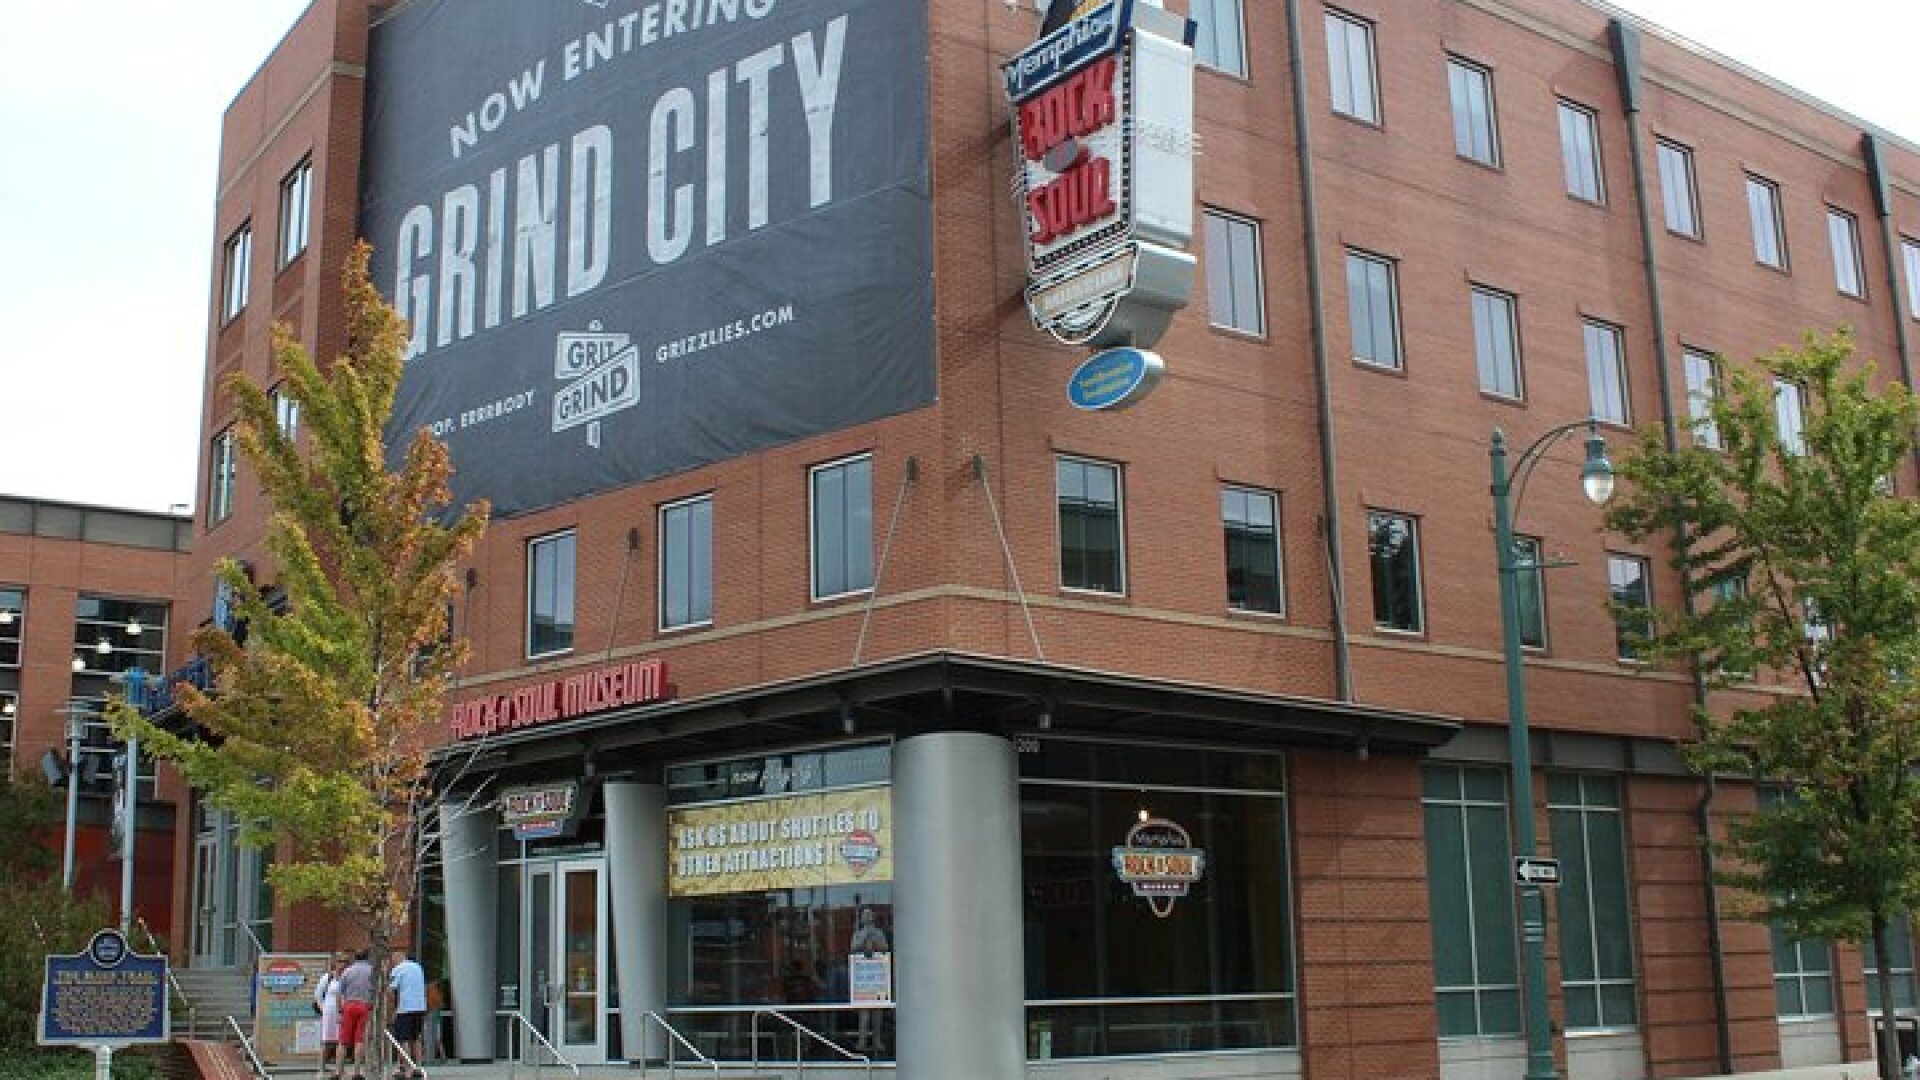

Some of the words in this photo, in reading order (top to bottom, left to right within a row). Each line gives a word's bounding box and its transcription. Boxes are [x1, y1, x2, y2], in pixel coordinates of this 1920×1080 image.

[450, 59, 545, 158] NOW
[564, 0, 774, 80] ENTERING
[1020, 57, 1116, 161] ROCK
[397, 124, 612, 361] GRIND
[647, 14, 849, 264] CITY
[1027, 157, 1116, 243] SOUL
[567, 340, 615, 369] GRIT
[655, 304, 794, 364] GRIZZLIES.COM
[559, 367, 628, 420] GRIND
[451, 696, 497, 739] ROCK
[511, 681, 560, 728] SOUL
[562, 657, 664, 718] MUSEUM
